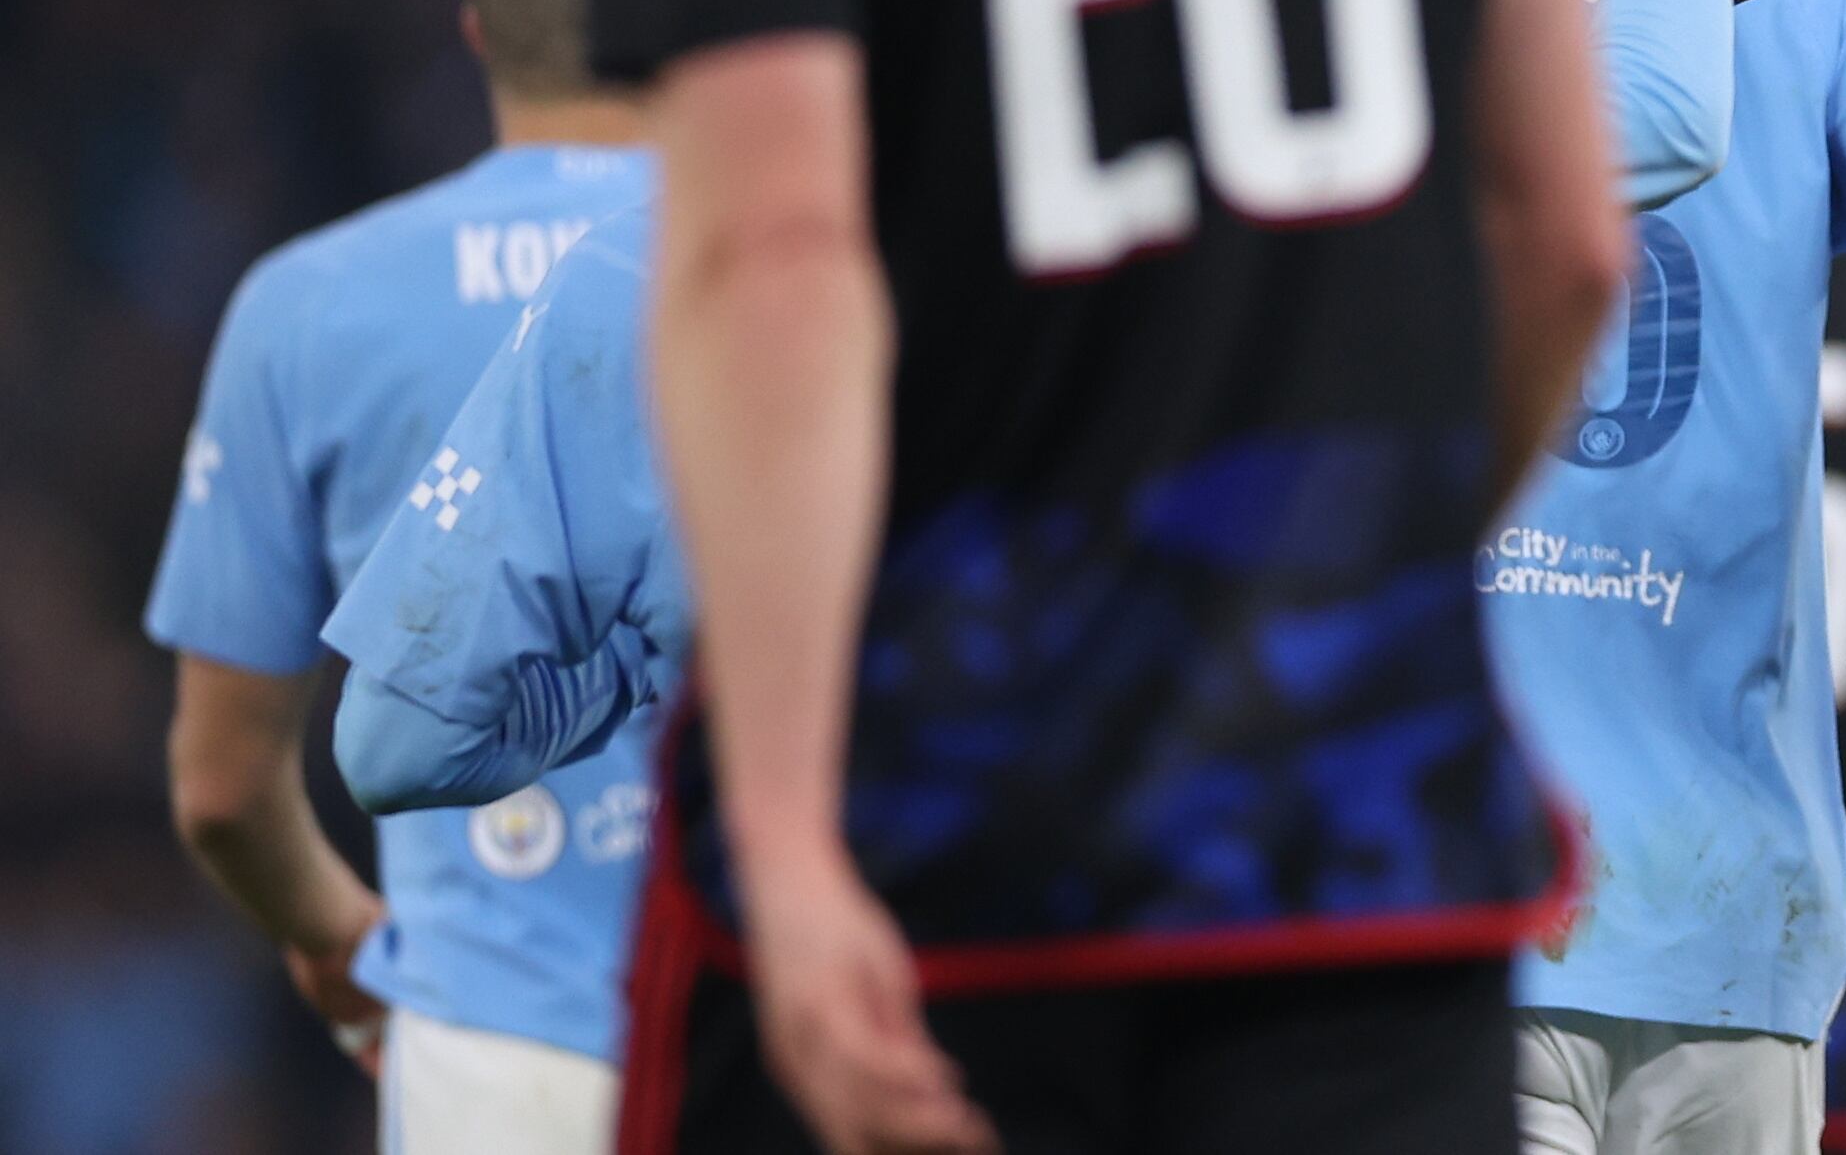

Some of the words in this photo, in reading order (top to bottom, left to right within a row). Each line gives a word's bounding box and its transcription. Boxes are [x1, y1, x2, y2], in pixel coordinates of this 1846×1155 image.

[1498, 526, 1567, 567] City
[1570, 543, 1588, 561] in
[1591, 543, 1622, 562] the
[1474, 545, 1684, 626] Community
